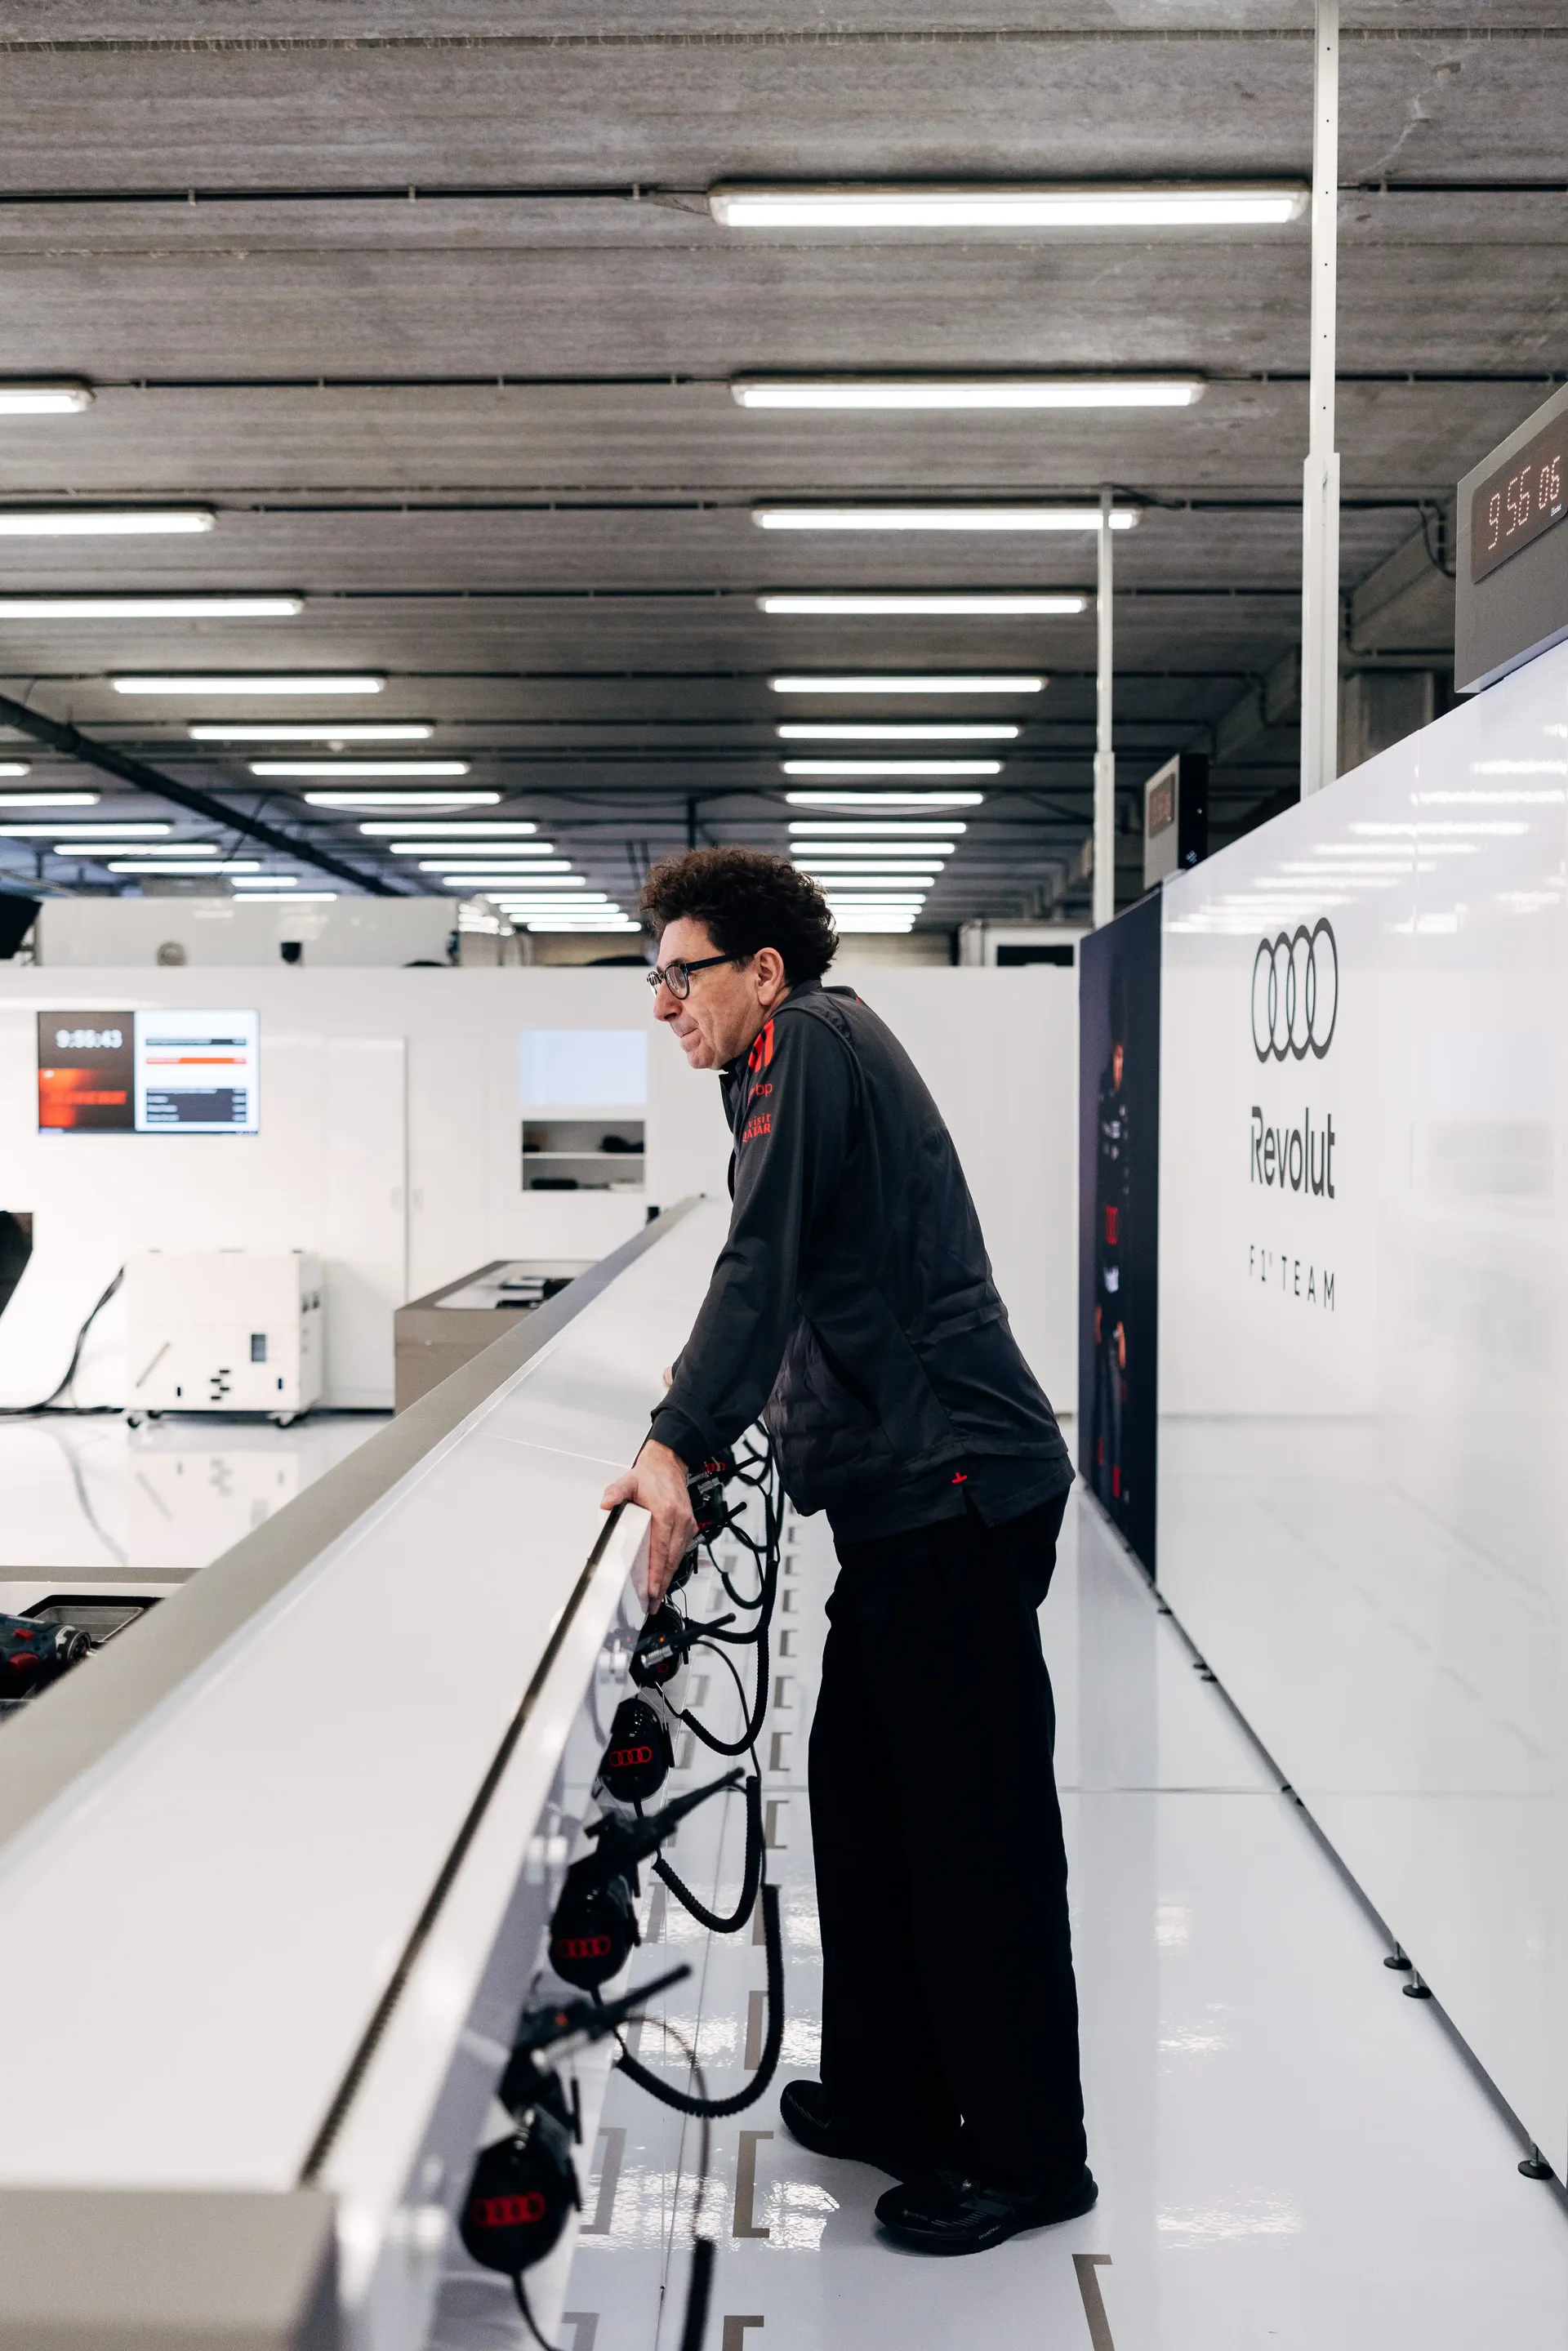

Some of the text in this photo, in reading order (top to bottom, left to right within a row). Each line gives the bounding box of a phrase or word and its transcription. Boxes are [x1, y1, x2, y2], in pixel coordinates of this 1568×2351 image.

[1488, 456, 1560, 550] 9 56 06
[755, 1083, 773, 1097] bp
[748, 1114, 771, 1128] visit
[1251, 1106, 1334, 1199] Revolut
[1281, 1255, 1334, 1311] TEAM
